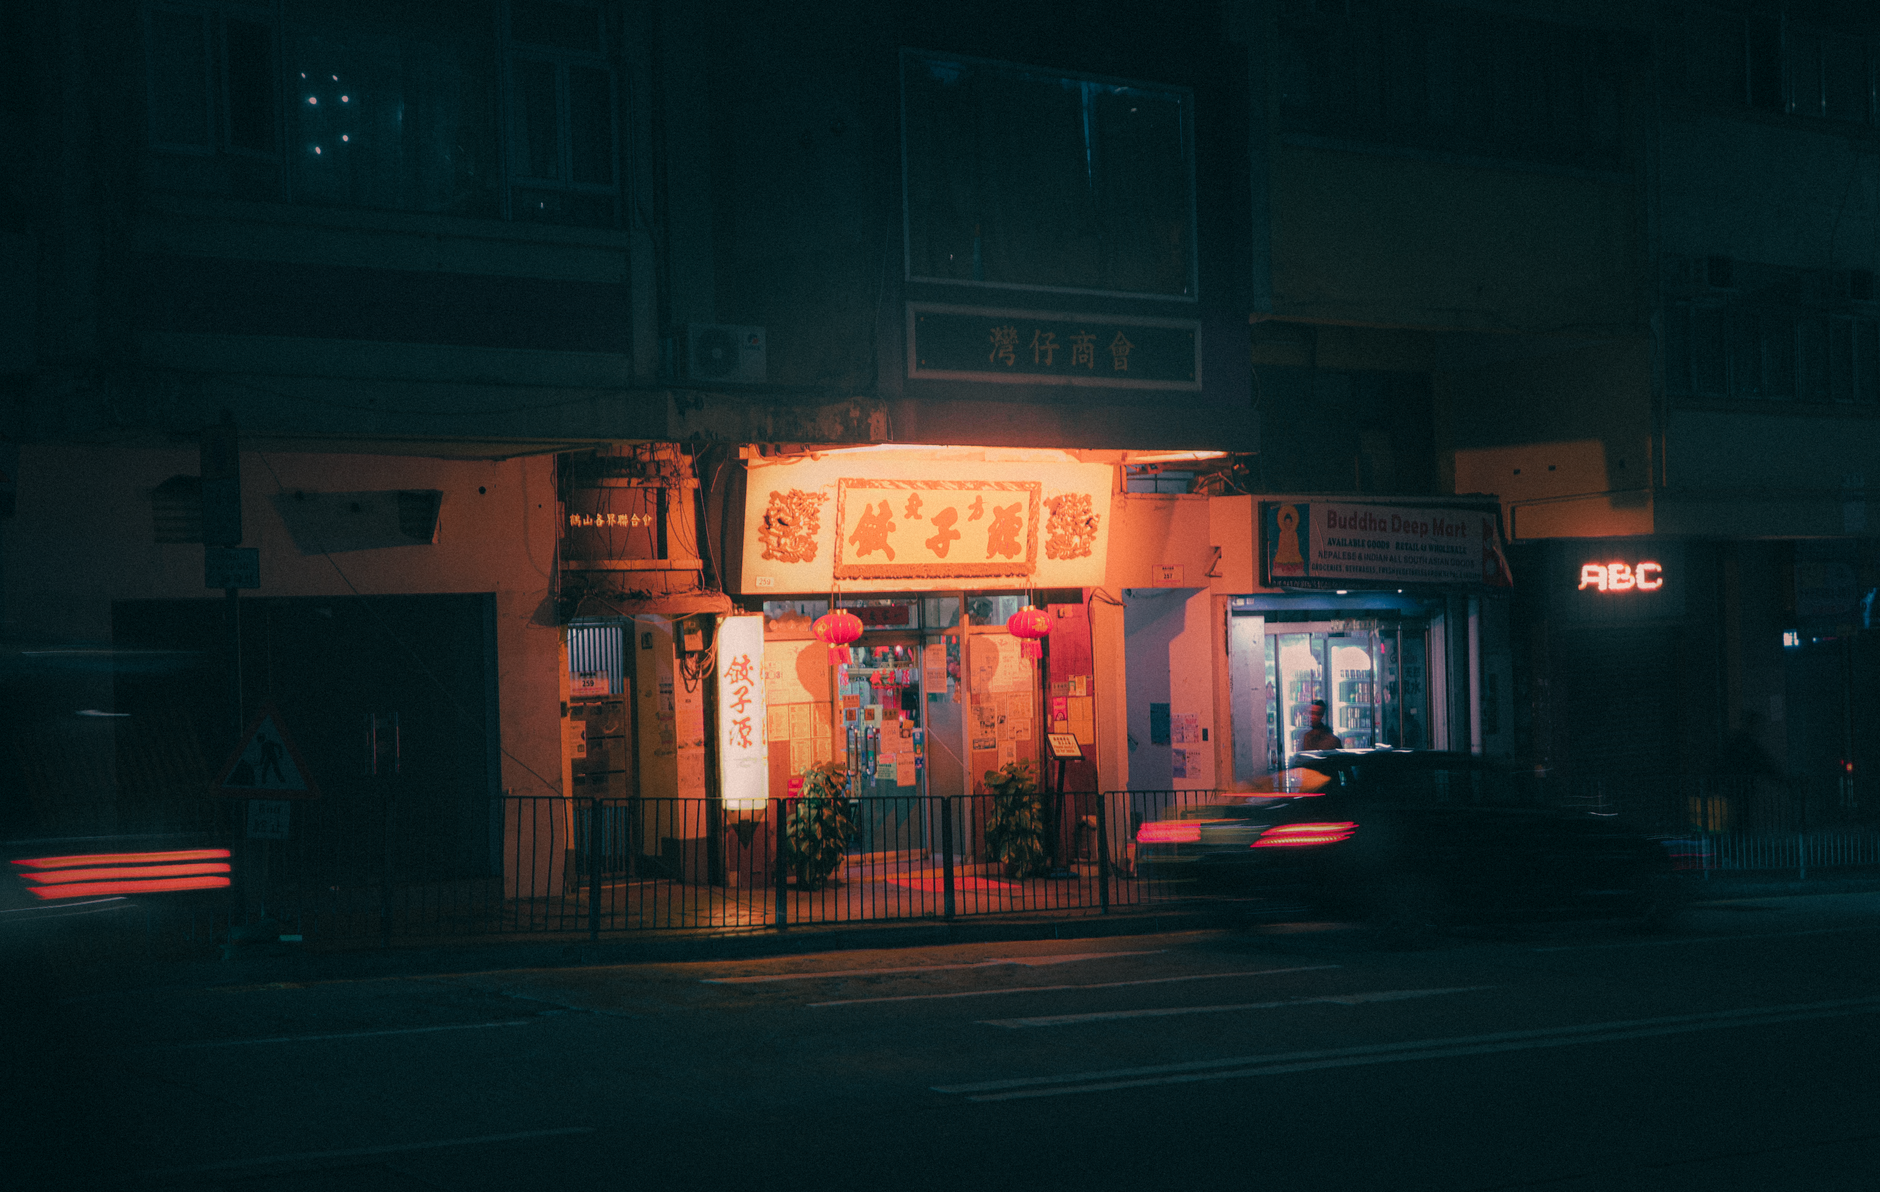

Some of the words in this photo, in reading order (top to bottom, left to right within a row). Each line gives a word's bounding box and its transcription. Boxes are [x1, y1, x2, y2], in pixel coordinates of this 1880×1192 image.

[989, 325, 1135, 372] 灣仔商會
[849, 498, 1023, 562] 餃子源
[1327, 510, 1387, 533] Buddha
[1391, 514, 1429, 537] Deep
[1432, 518, 1467, 538] Mart
[1318, 550, 1356, 561] NEPALESE
[1364, 553, 1388, 563] INDIAN
[1403, 555, 1427, 565] SOUTH
[1428, 556, 1449, 566] ASIAN
[1450, 558, 1475, 569] GOODS
[1327, 537, 1365, 548] AVAILABLE
[1367, 539, 1390, 550] GOODS
[1395, 541, 1419, 552] RETAIL
[1428, 544, 1467, 555] WHOLESALE
[758, 577, 772, 586] 259
[1577, 561, 1664, 592] ABC
[582, 679, 595, 687] 259
[724, 654, 754, 749] 餃子源
